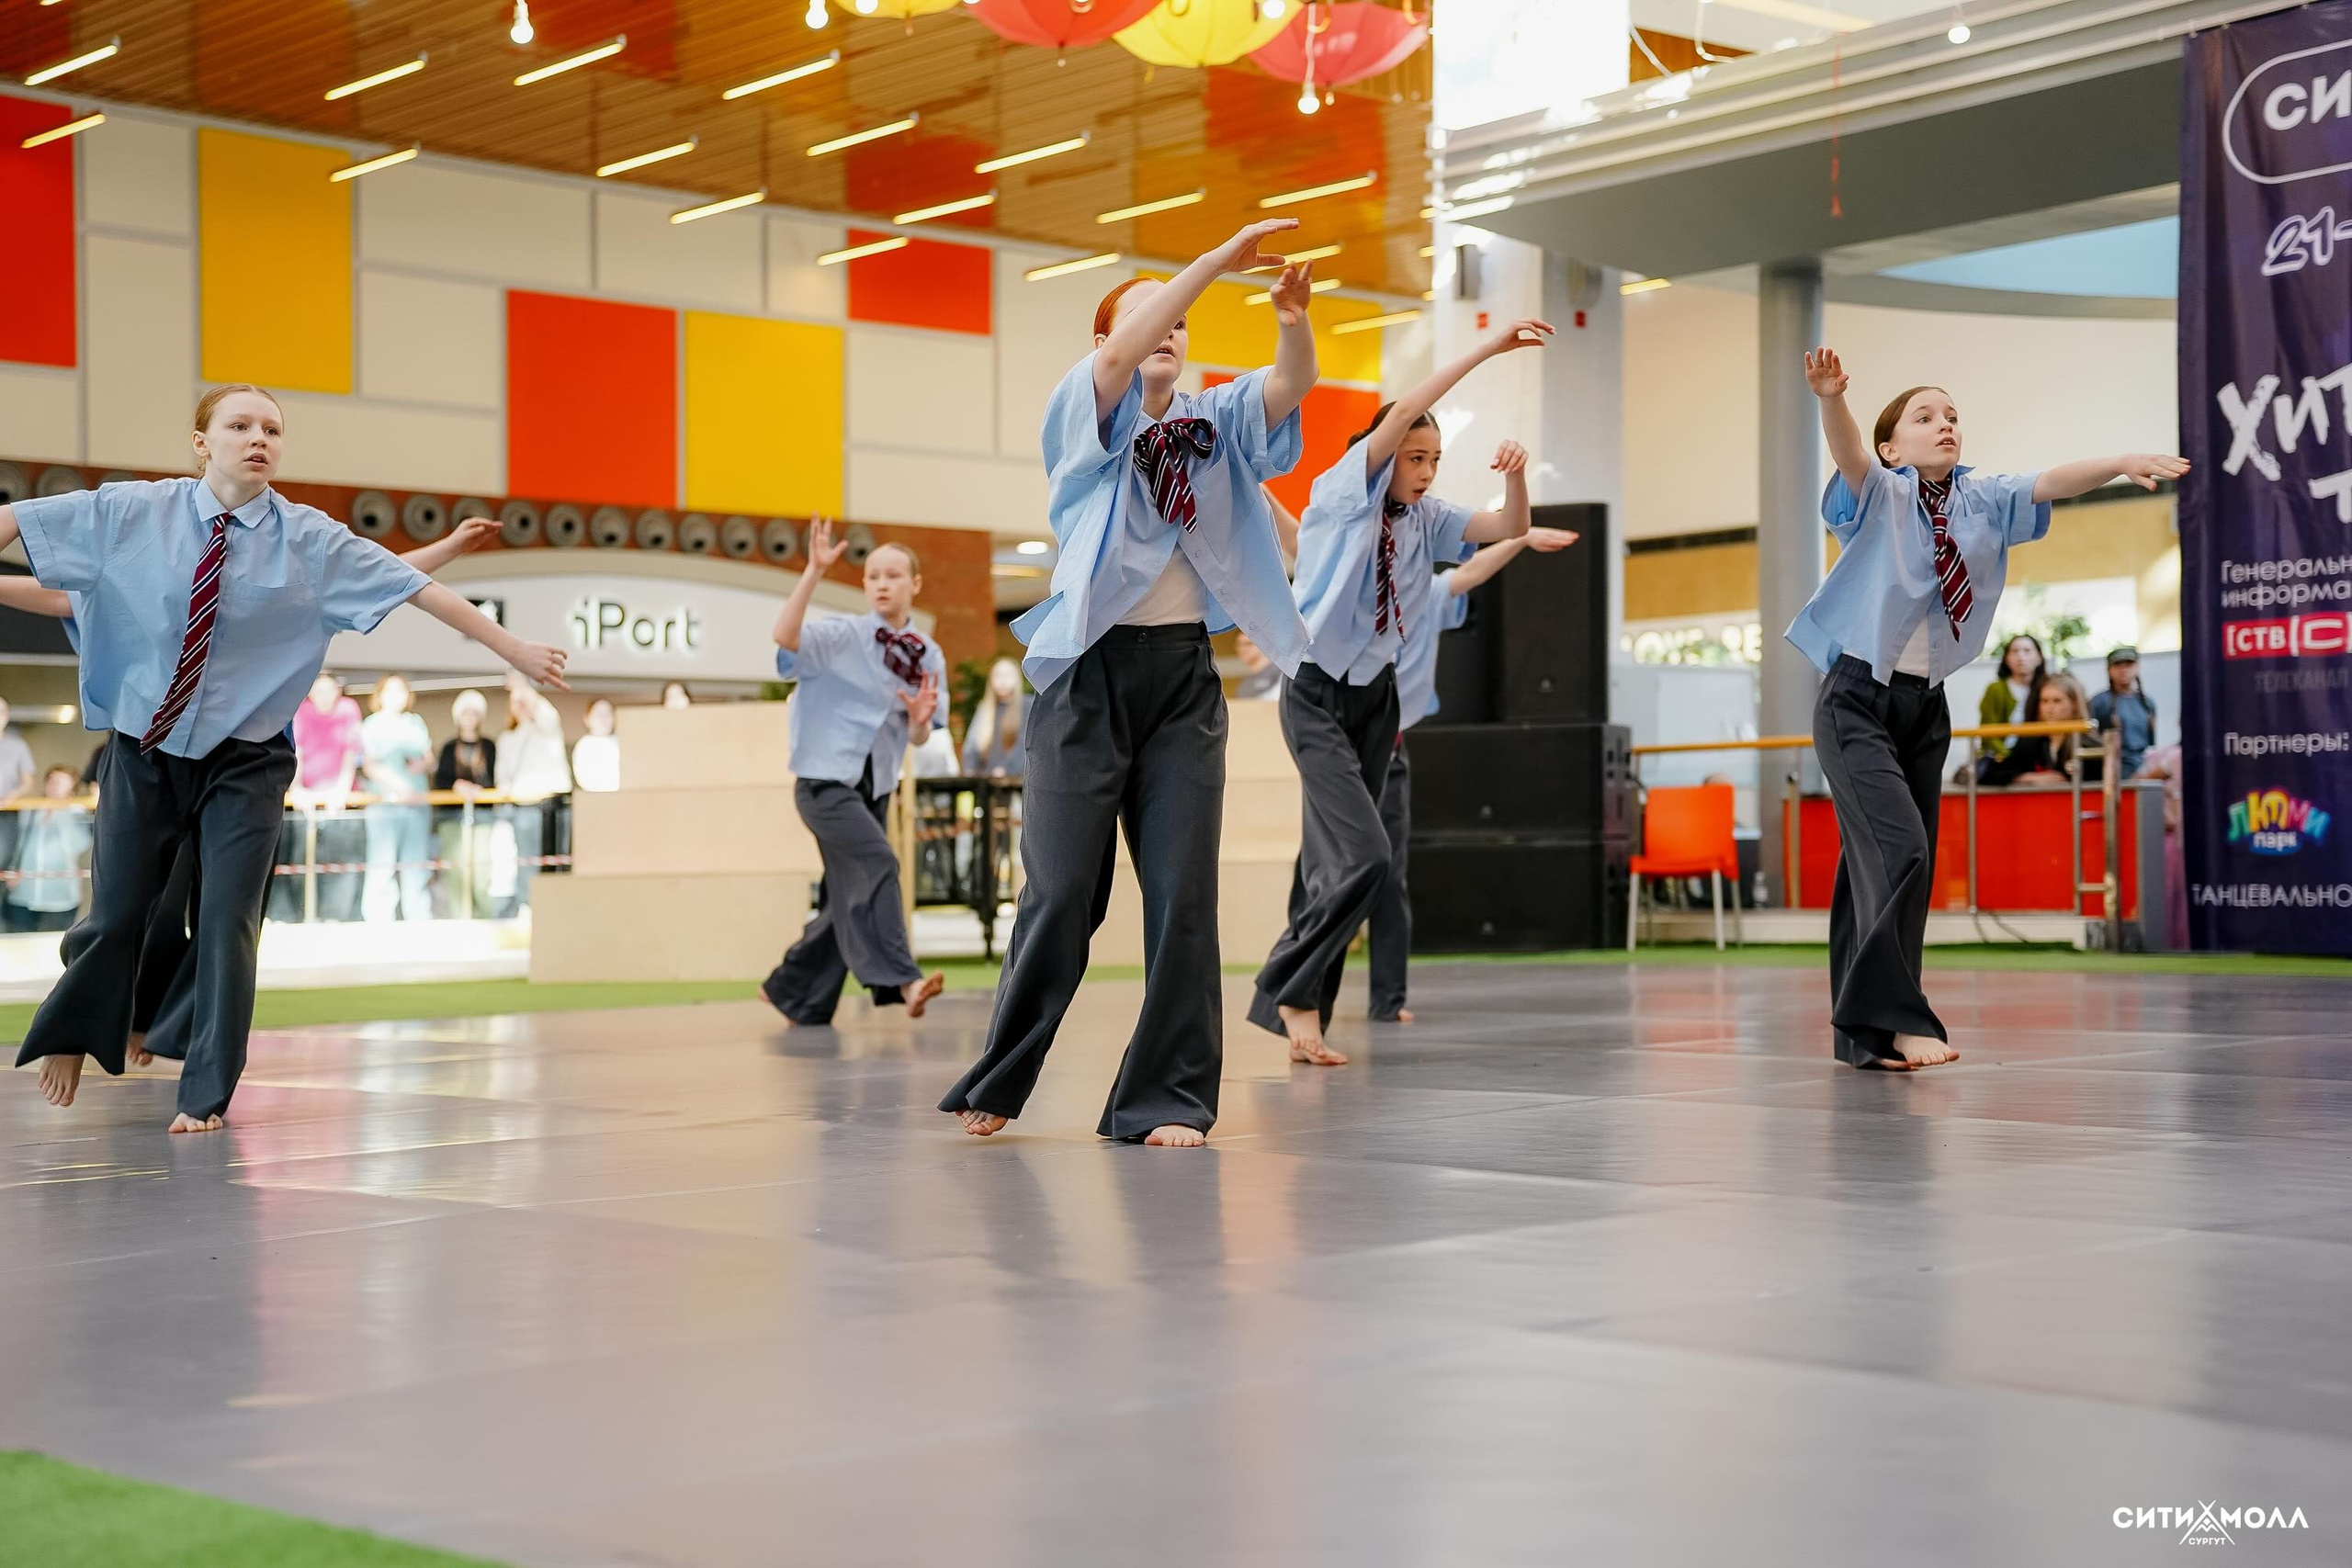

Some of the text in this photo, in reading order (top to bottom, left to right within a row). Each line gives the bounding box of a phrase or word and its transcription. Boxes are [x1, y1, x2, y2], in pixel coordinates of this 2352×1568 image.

[2221, 580, 2352, 611] информа
[574, 598, 704, 649] iPort
[2224, 732, 2349, 759] Партнеры:
